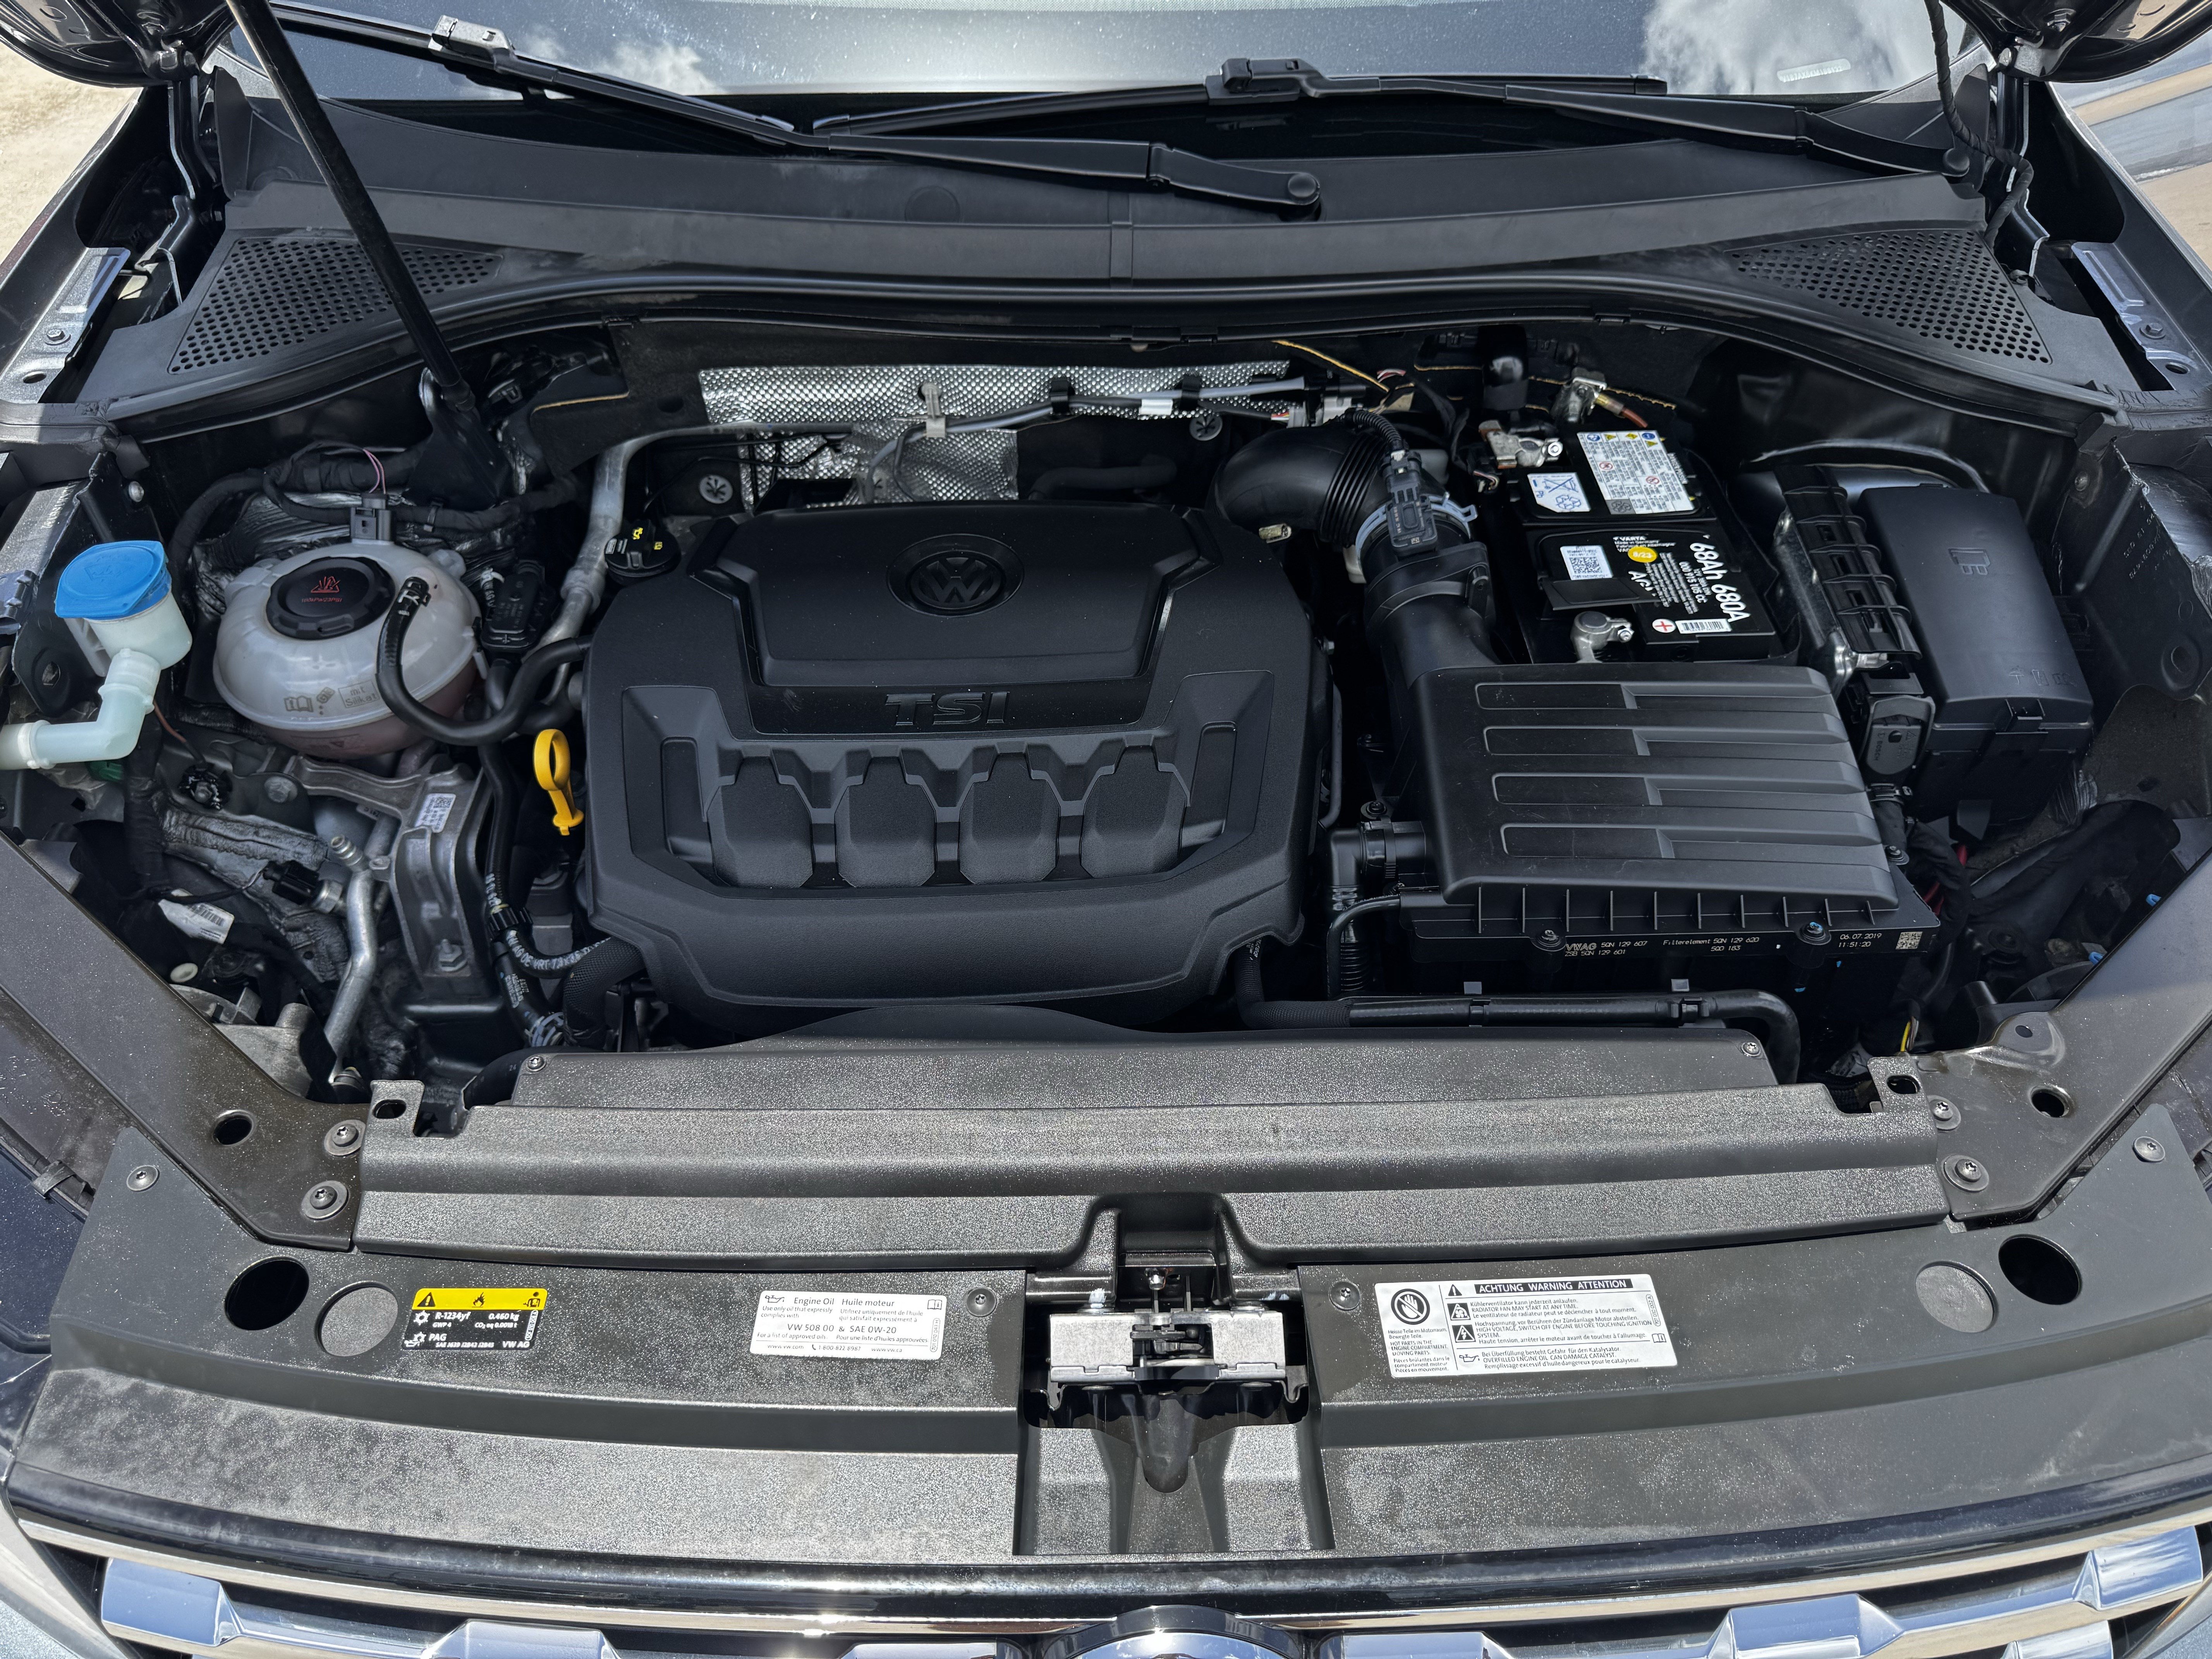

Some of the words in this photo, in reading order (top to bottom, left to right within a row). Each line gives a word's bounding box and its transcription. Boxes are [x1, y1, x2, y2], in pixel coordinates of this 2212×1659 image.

[1679, 562, 1693, 573] 000
[1684, 572, 1698, 583] 915
[1690, 543, 1728, 580] 68Ah
[1711, 584, 1751, 622] 680A
[1690, 584, 1704, 594] 105
[349, 686, 366, 696] mit
[345, 693, 378, 707] Silikat
[885, 691, 1010, 726] TSI
[1478, 1283, 1523, 1293] ACHTUNG
[1528, 1281, 1573, 1291] WARNING
[1576, 1279, 1627, 1289] ATTENTION
[793, 1297, 821, 1306] Engine
[434, 1312, 471, 1321] R-1234yf
[1491, 1350, 1525, 1358] Überfüllung
